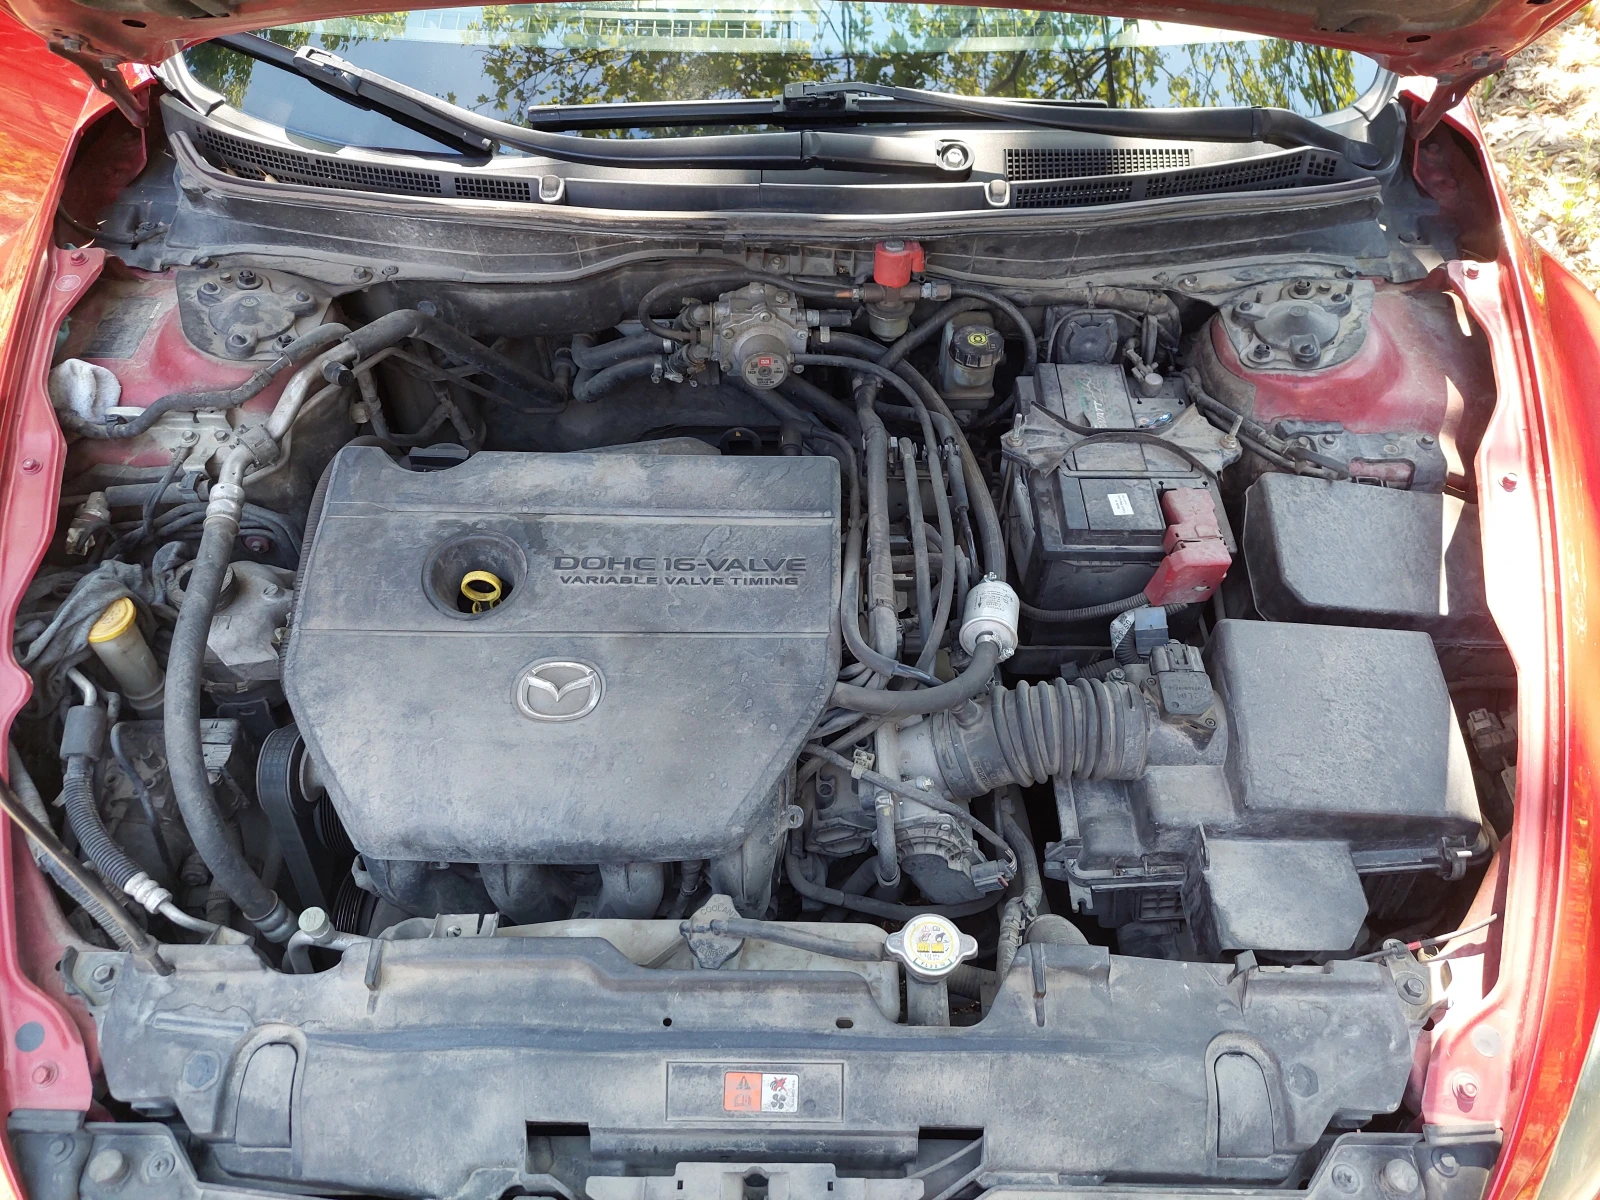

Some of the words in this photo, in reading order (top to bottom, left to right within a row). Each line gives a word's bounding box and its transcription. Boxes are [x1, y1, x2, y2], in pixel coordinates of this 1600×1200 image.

[554, 556, 656, 571] DOHC
[663, 557, 807, 572] 16-VALVE
[560, 575, 659, 585] VARIABLE
[664, 576, 725, 586] VALVE
[730, 577, 799, 586] TIMING
[700, 904, 738, 919] COOLANT
